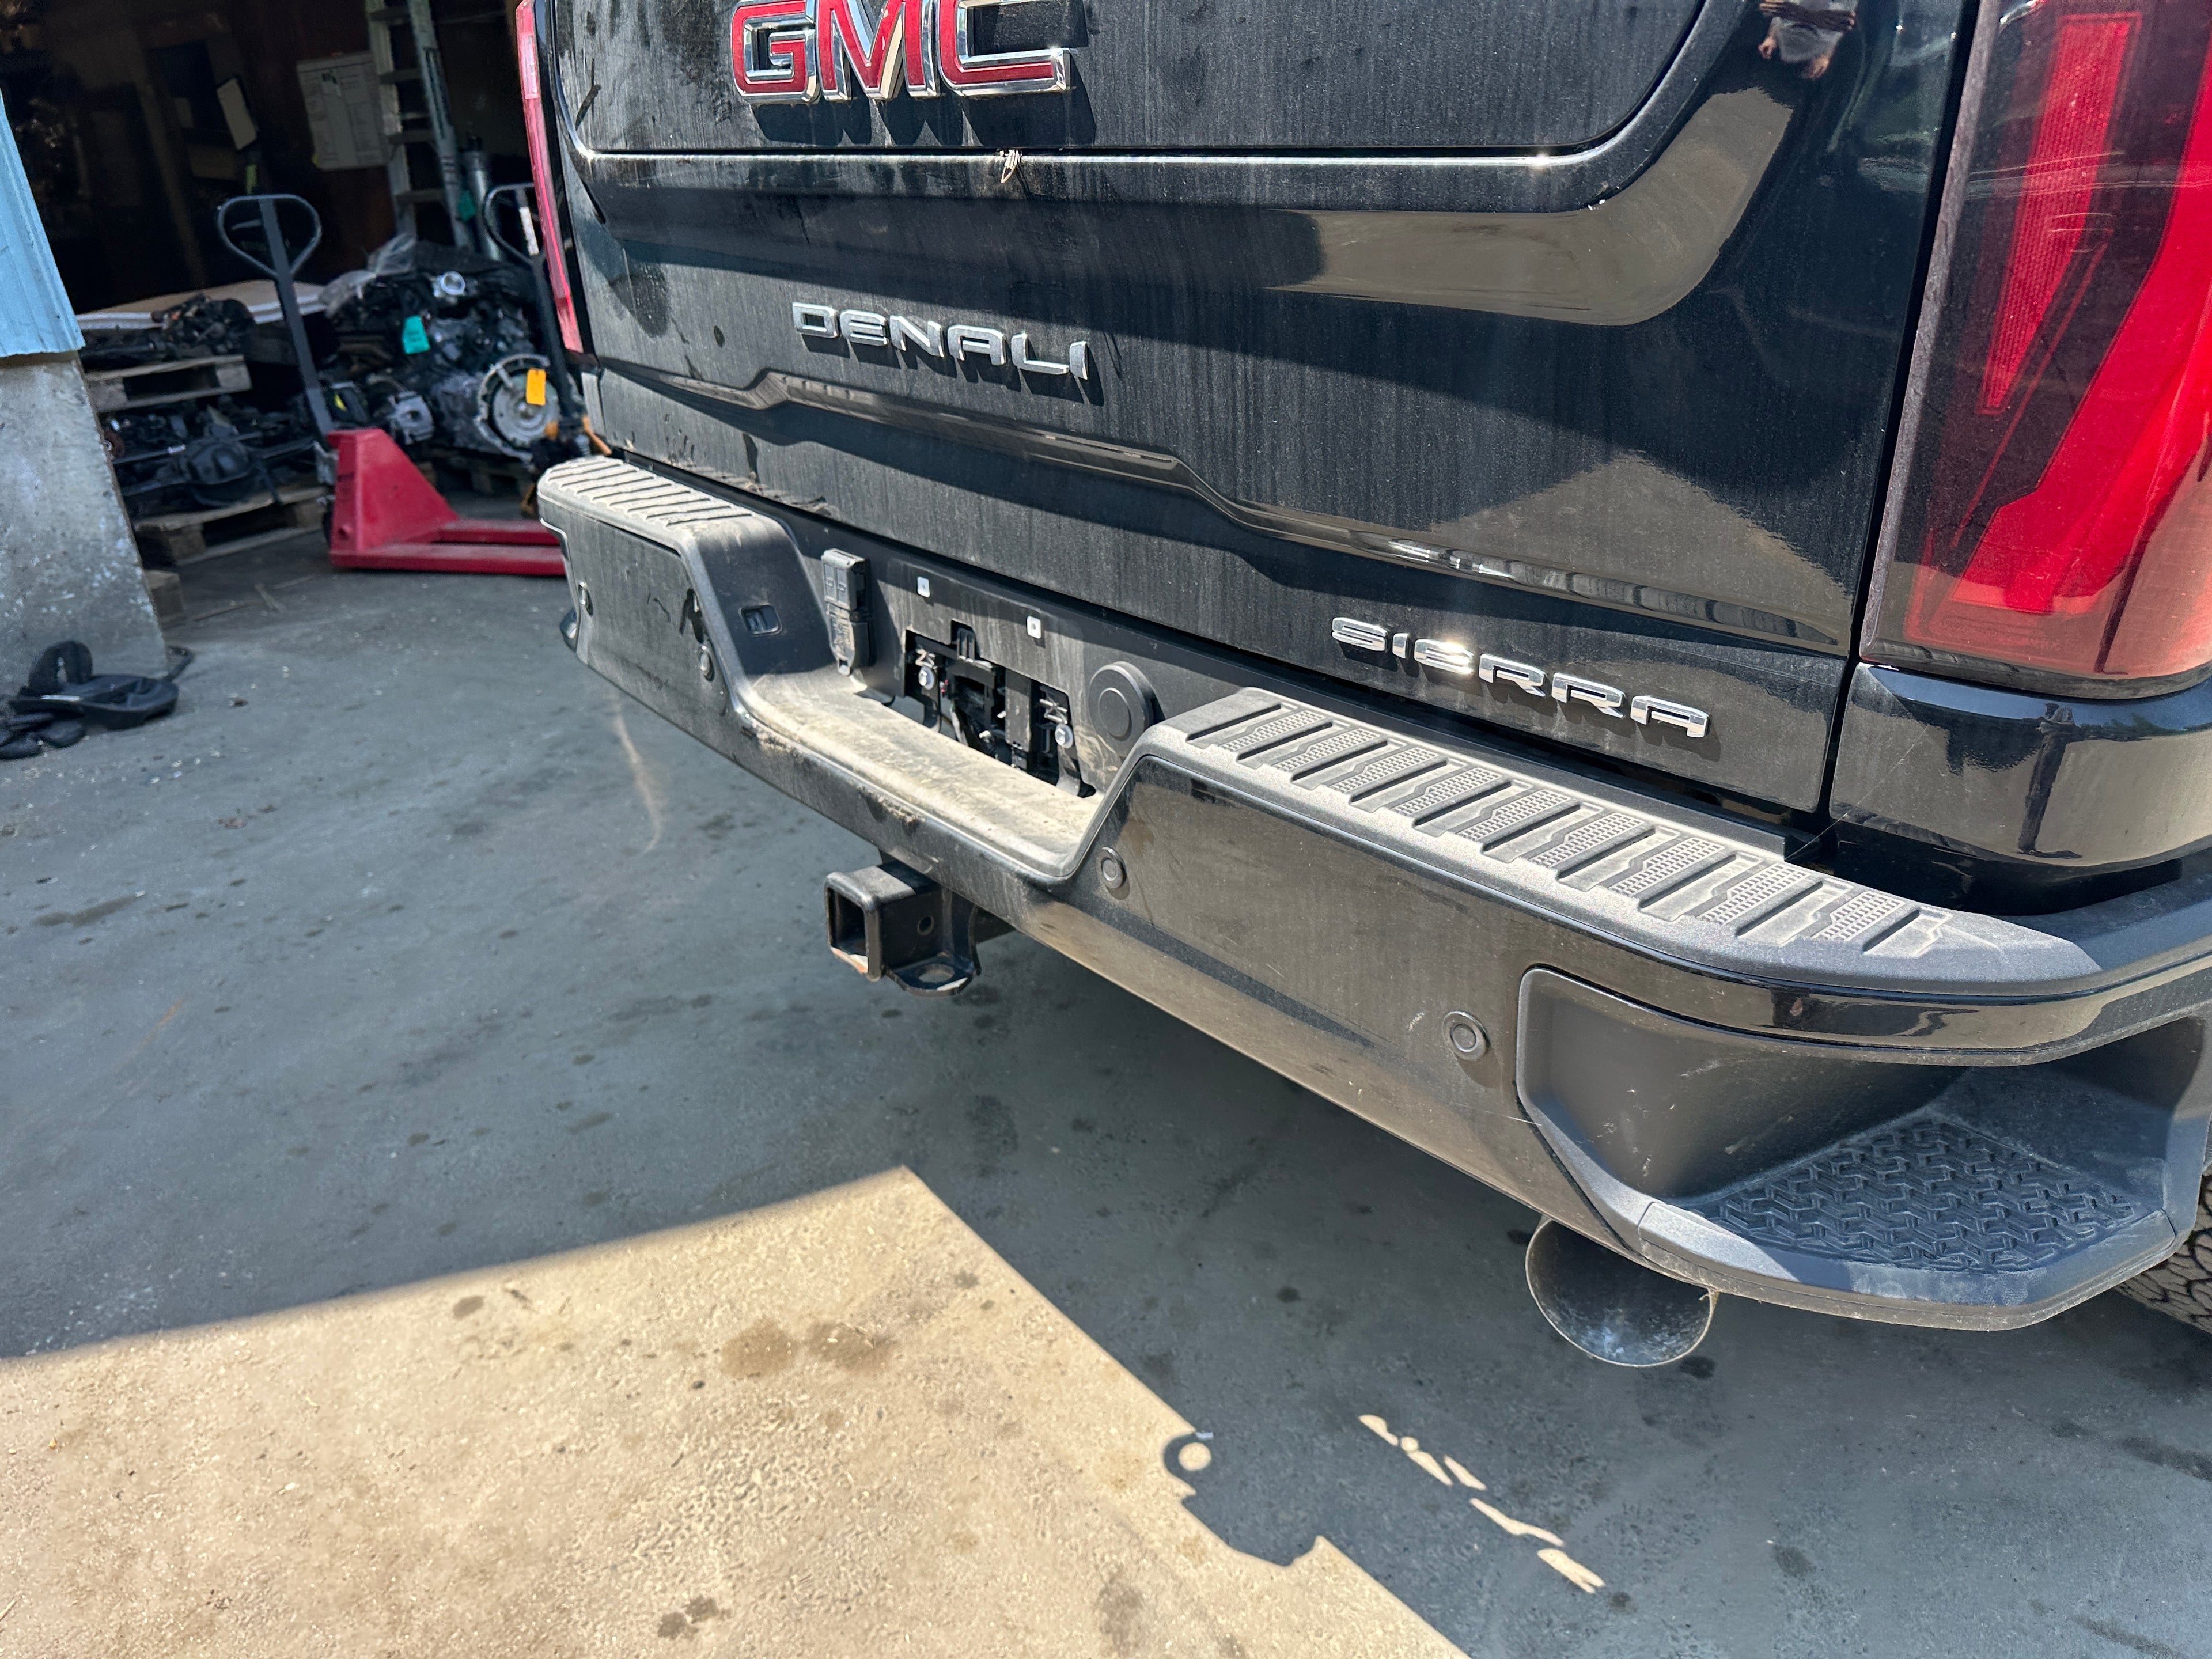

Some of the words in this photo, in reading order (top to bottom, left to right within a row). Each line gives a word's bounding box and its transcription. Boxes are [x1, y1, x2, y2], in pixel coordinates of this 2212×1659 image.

[730, 0, 1072, 103] GMC
[792, 301, 1089, 380] DENALI
[1331, 616, 1710, 738] SIERRA
